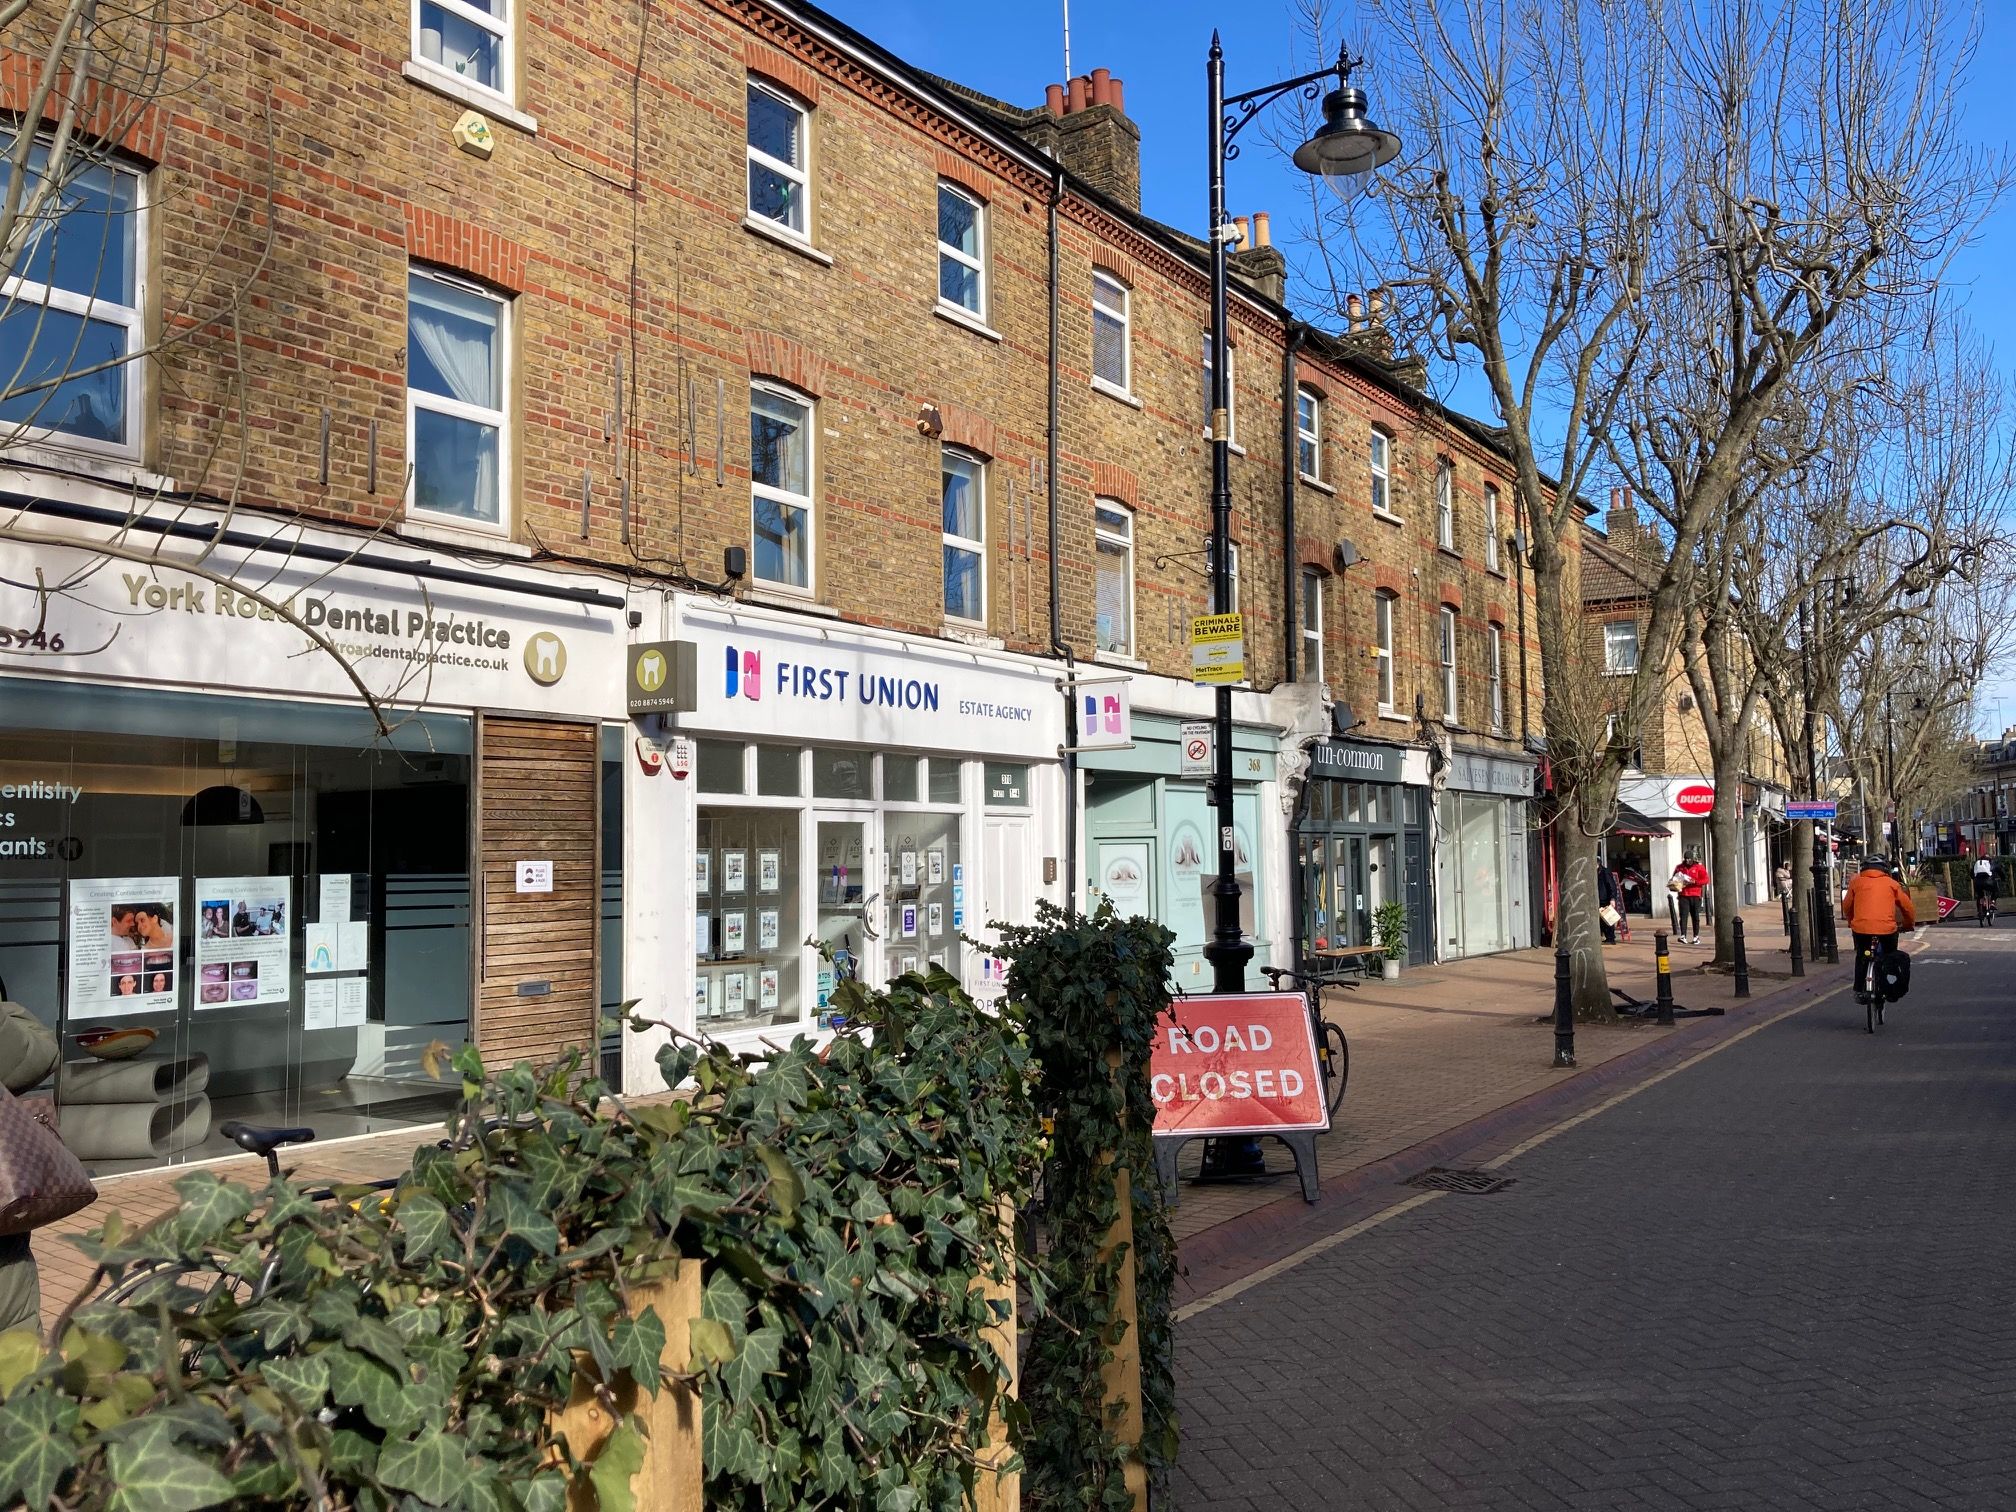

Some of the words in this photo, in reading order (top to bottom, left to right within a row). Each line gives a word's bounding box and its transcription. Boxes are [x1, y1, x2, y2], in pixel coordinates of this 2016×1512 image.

[122, 573, 205, 614] York
[305, 597, 400, 637] Dental
[407, 611, 511, 650] Practice
[1194, 616, 1240, 627] CRIMINALS
[1194, 624, 1241, 636] BEWARE
[630, 700, 642, 708] 020
[643, 699, 658, 707] 8874
[658, 697, 675, 705] 5946
[777, 662, 850, 701] FIRST
[859, 673, 939, 713] UNION
[959, 700, 994, 718] ESTATE
[996, 705, 1032, 722] AGENCY
[1248, 758, 1261, 772] 368
[1317, 745, 1384, 771] un-common
[0, 837, 46, 855] ants
[1167, 1024, 1273, 1055] ROAD
[1150, 1069, 1304, 1103] CLOSED
